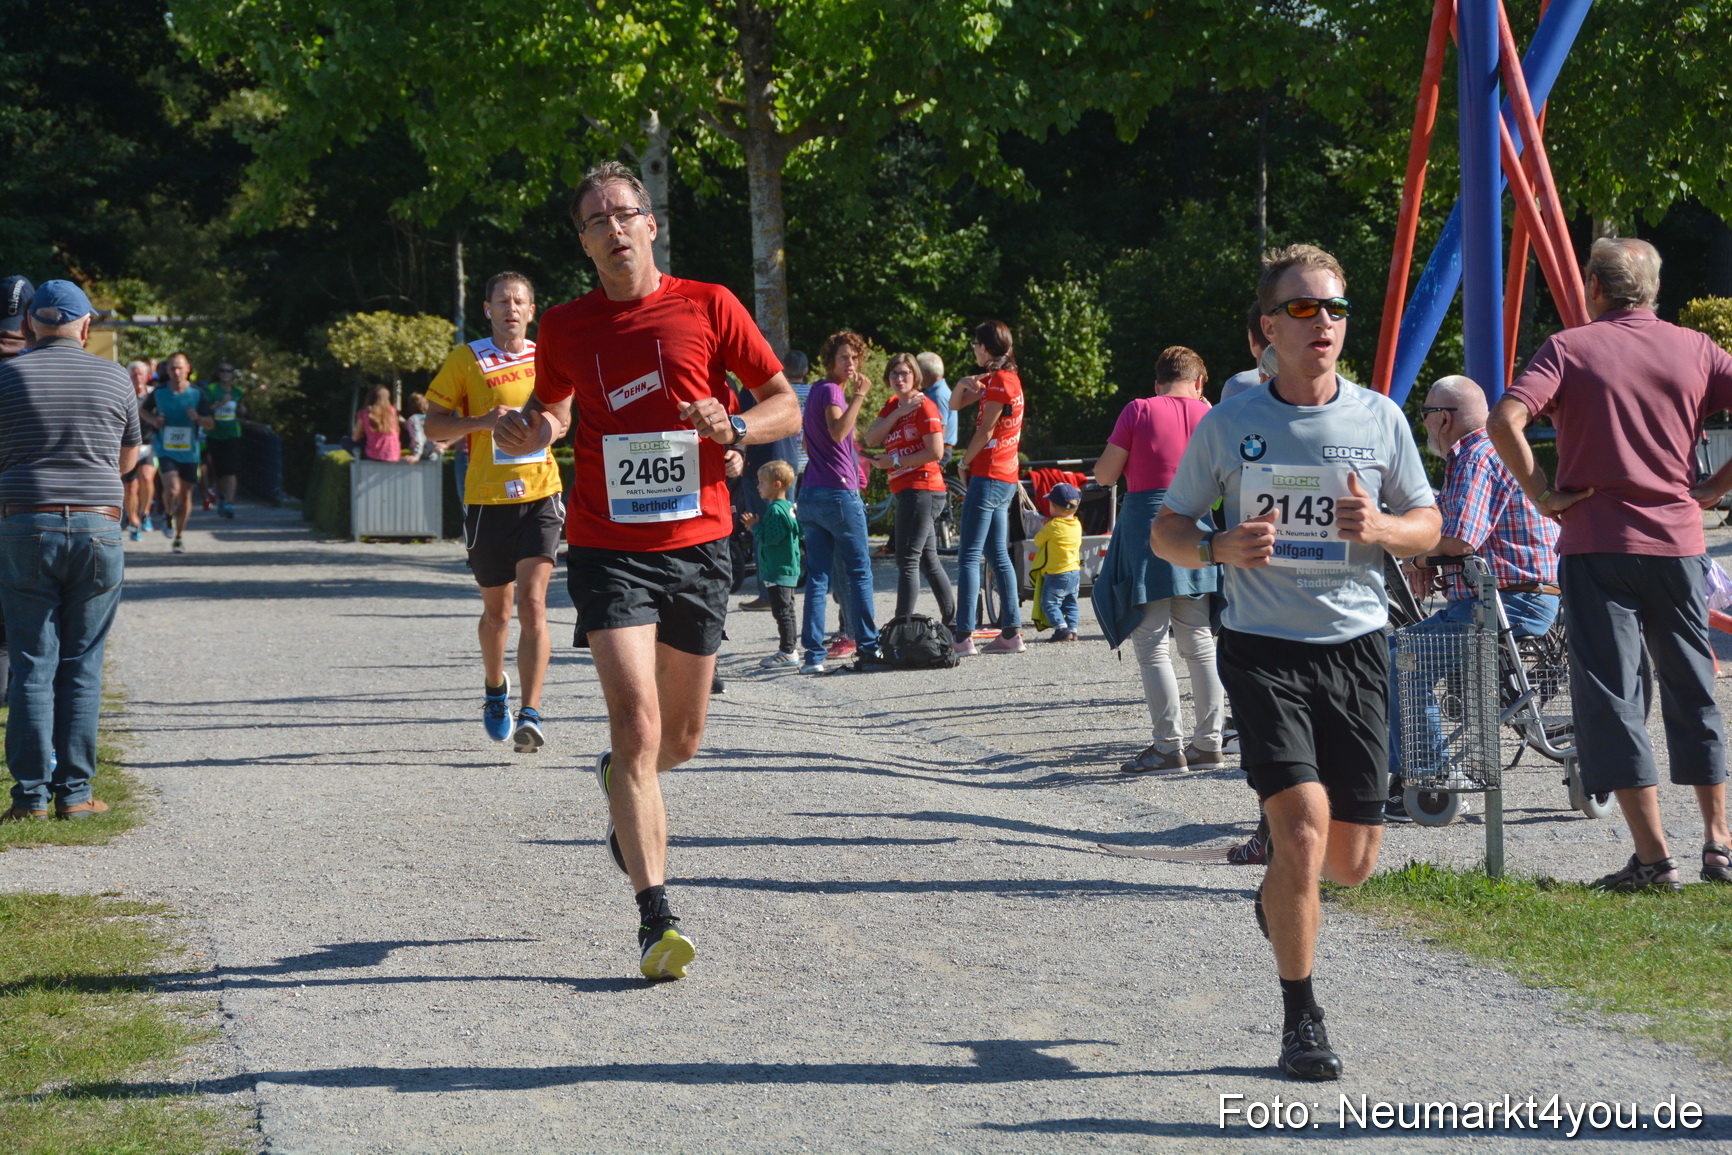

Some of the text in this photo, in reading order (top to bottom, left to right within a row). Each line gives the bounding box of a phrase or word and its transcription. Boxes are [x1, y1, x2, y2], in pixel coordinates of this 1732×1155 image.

[486, 367, 536, 388] MAX B
[624, 381, 647, 399] DEHN
[629, 439, 671, 451] BOCK
[1322, 446, 1376, 460] BOCK
[618, 456, 686, 486] 2465
[1272, 475, 1320, 487] BOCK
[646, 487, 674, 495] Neumarkt
[631, 498, 678, 512] Berthold
[1256, 493, 1334, 526] 2143
[1285, 530, 1318, 538] Neumarkt
[1273, 543, 1324, 560] olfgang
